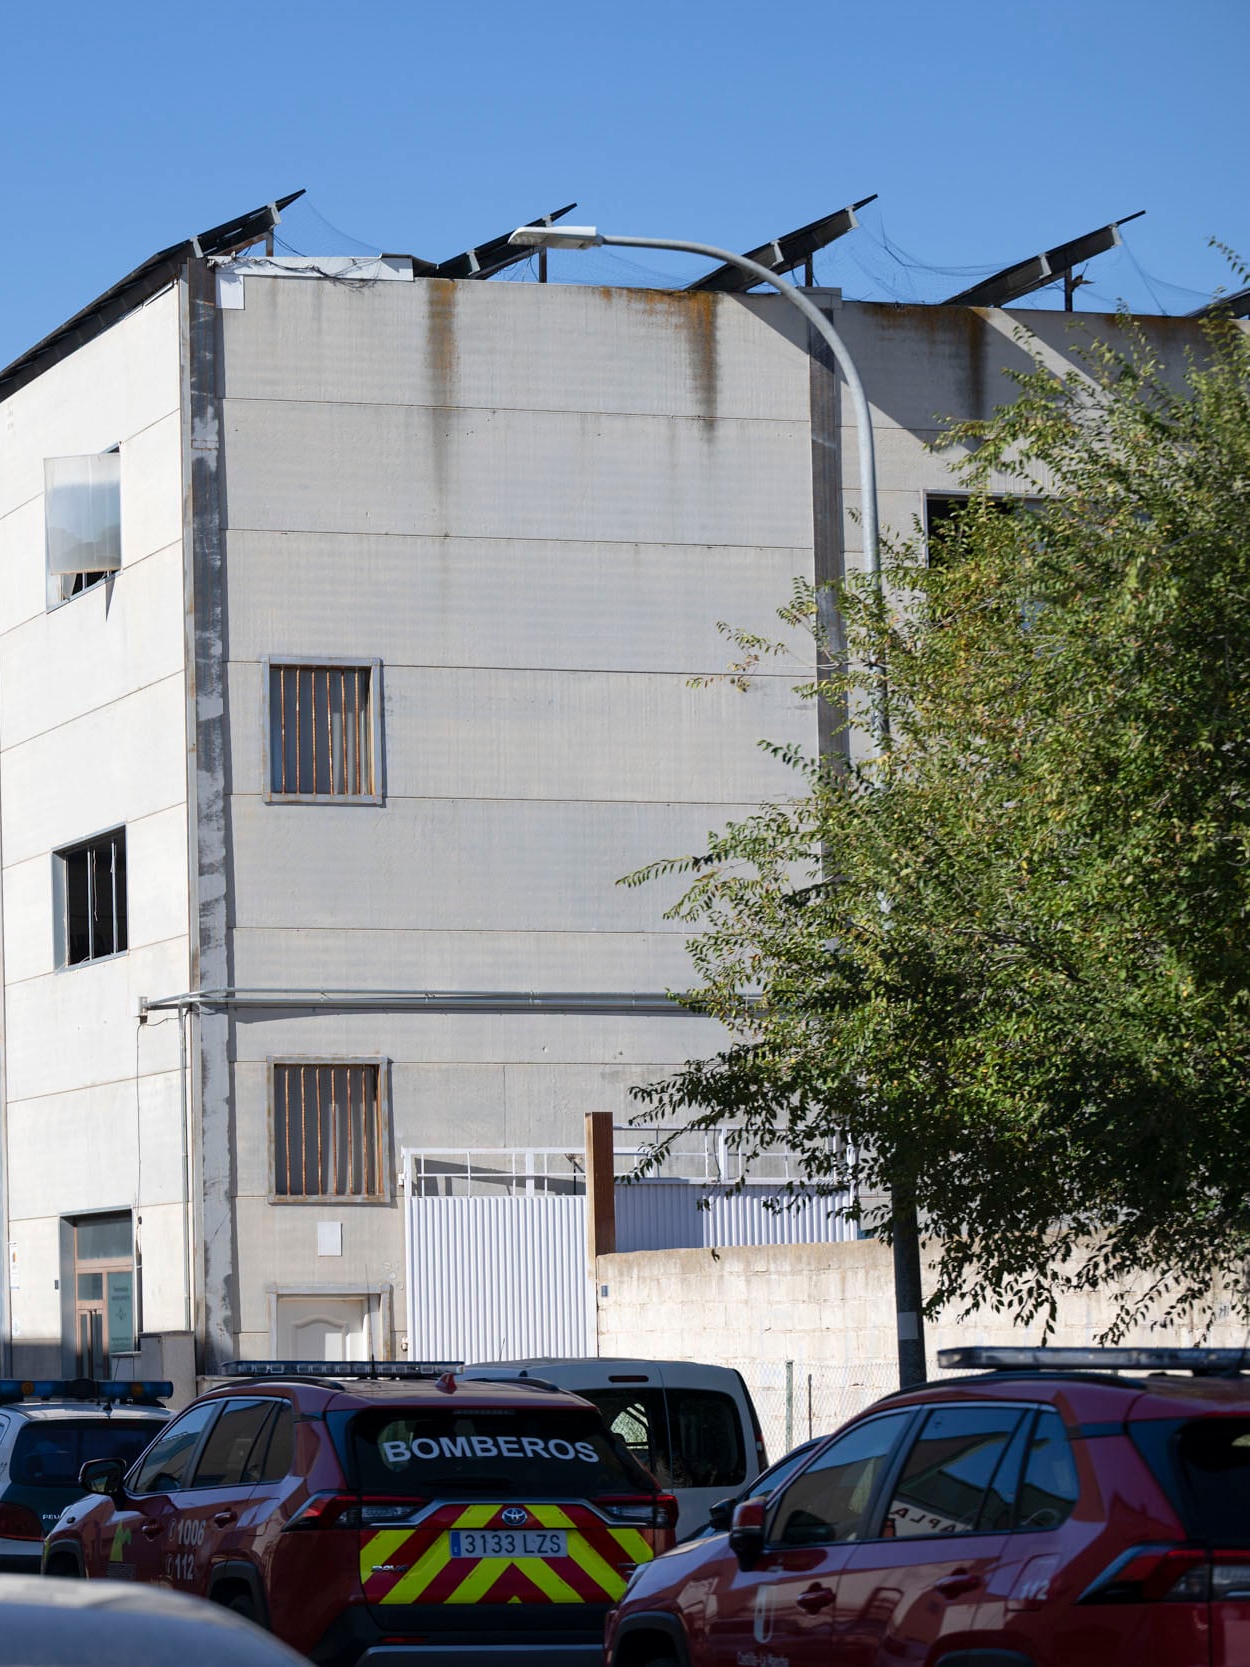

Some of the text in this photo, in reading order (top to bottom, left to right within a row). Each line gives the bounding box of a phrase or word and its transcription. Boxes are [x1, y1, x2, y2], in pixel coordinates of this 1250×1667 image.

[382, 1435, 600, 1464] BOMBEROS
[177, 1519, 207, 1546] 1006
[465, 1534, 561, 1553] 3133 LZS
[175, 1552, 195, 1581] 112
[1020, 1579, 1049, 1601] 112
